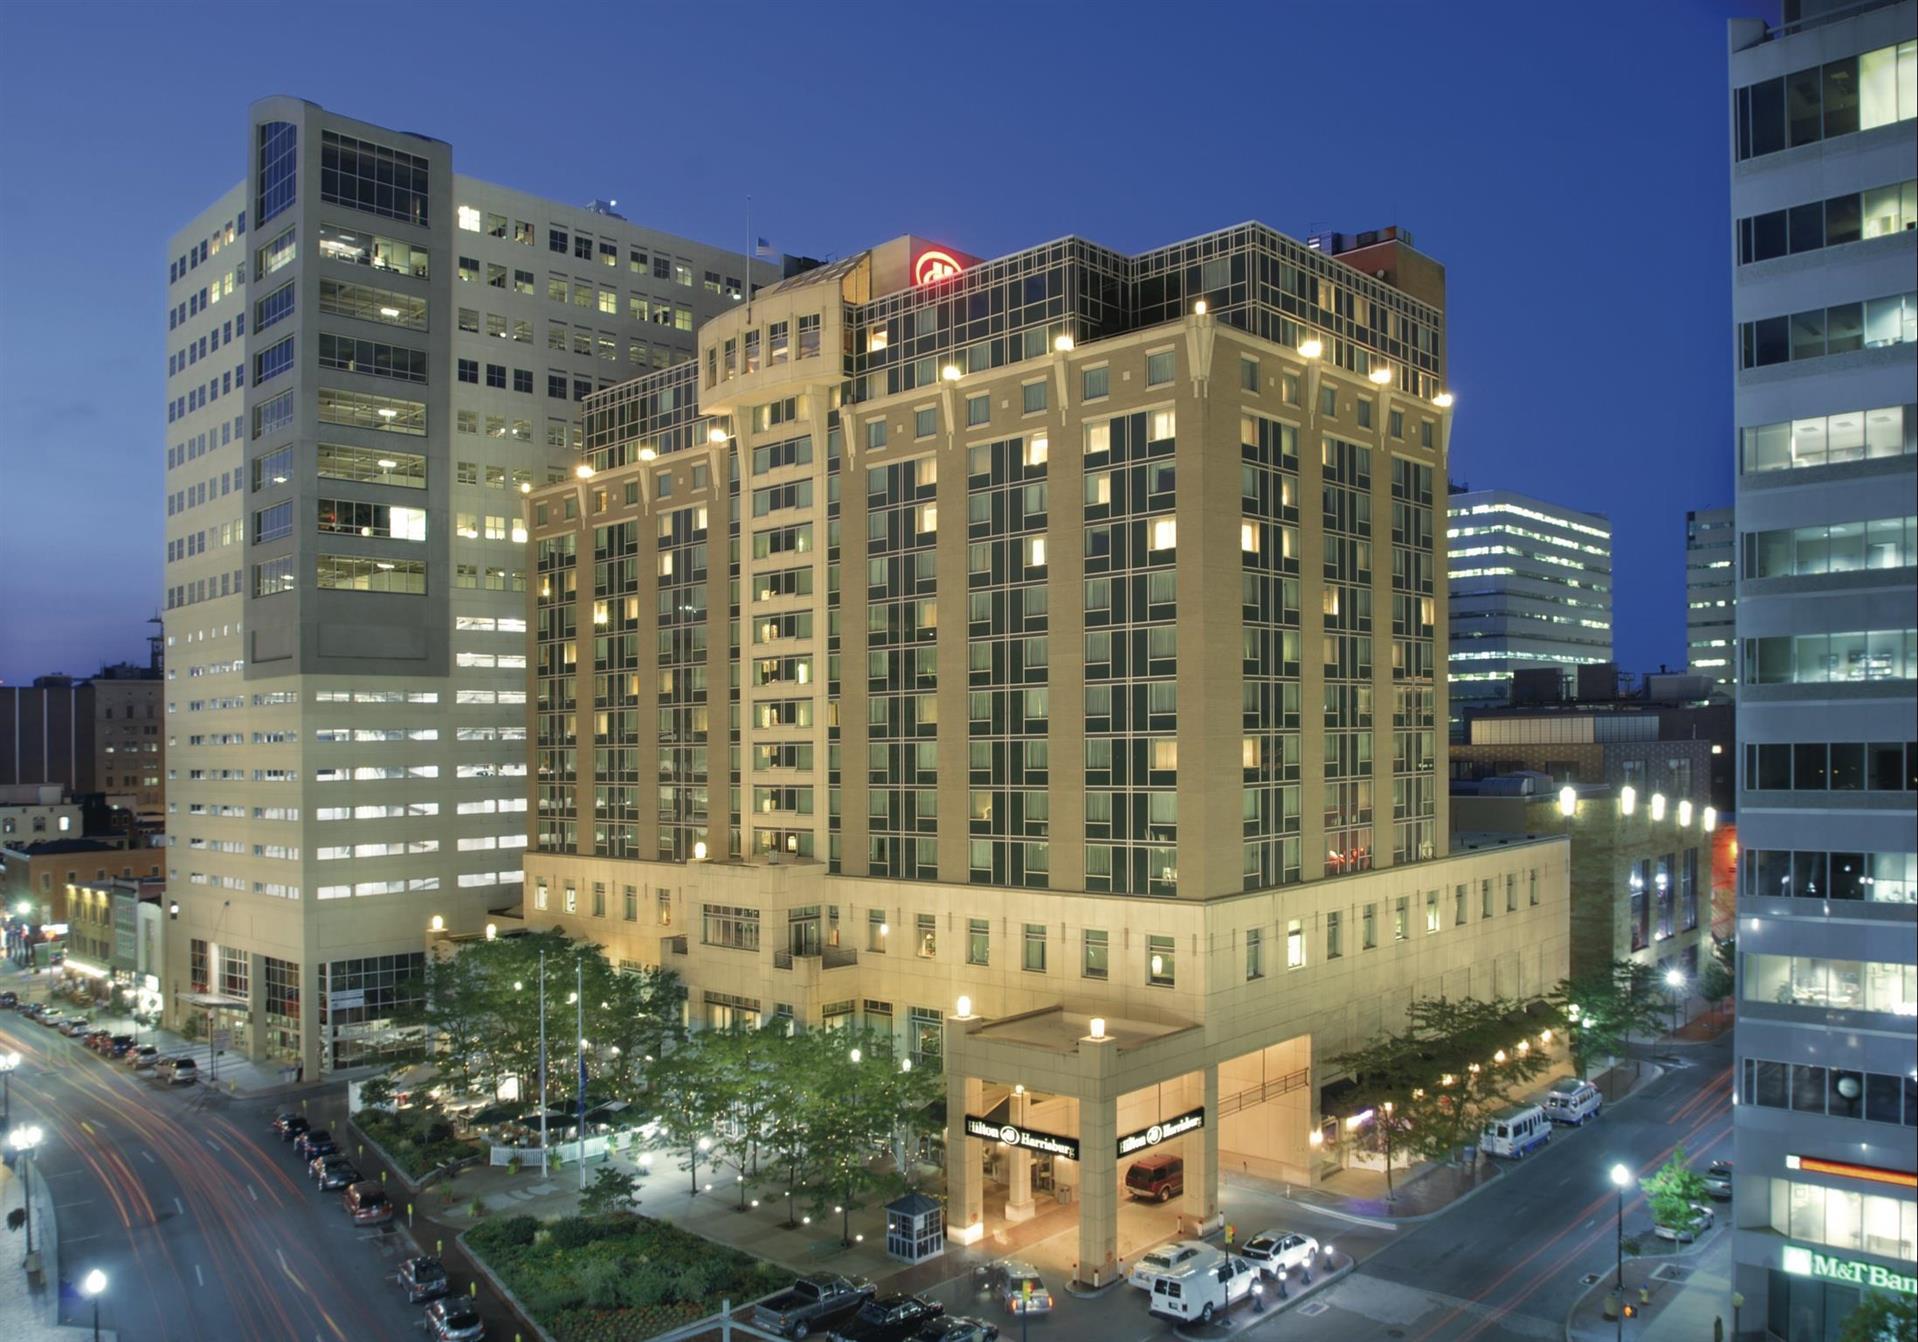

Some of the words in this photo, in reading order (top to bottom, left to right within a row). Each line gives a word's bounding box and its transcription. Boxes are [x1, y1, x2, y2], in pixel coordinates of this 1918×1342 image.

[968, 1121, 999, 1139] Hilton
[1021, 1132, 1075, 1158] Harrisburg
[1814, 1254, 1868, 1283] M&T
